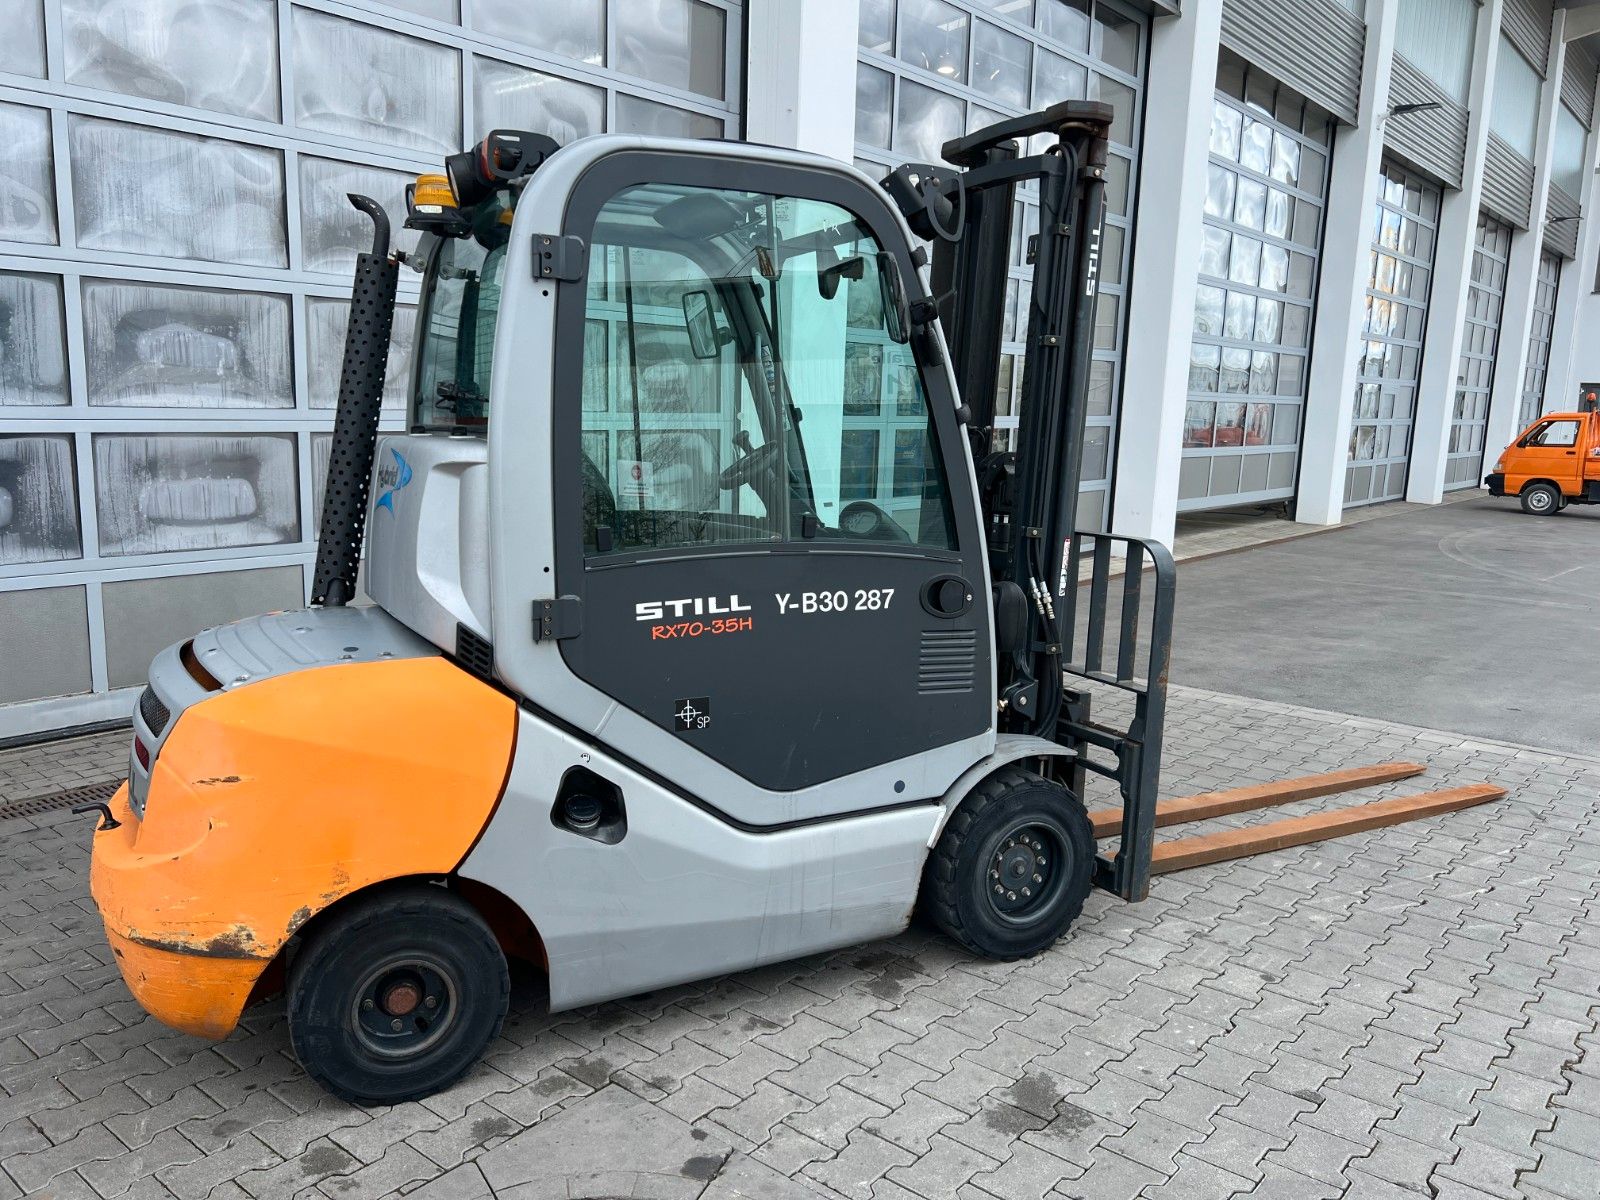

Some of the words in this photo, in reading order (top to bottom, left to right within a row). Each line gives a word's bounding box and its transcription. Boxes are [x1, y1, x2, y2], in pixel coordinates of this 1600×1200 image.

[635, 595, 751, 621] STILL
[775, 590, 849, 615] Y-B30
[854, 588, 895, 611] 287
[652, 617, 752, 640] RX70-35H
[697, 716, 711, 729] SP
